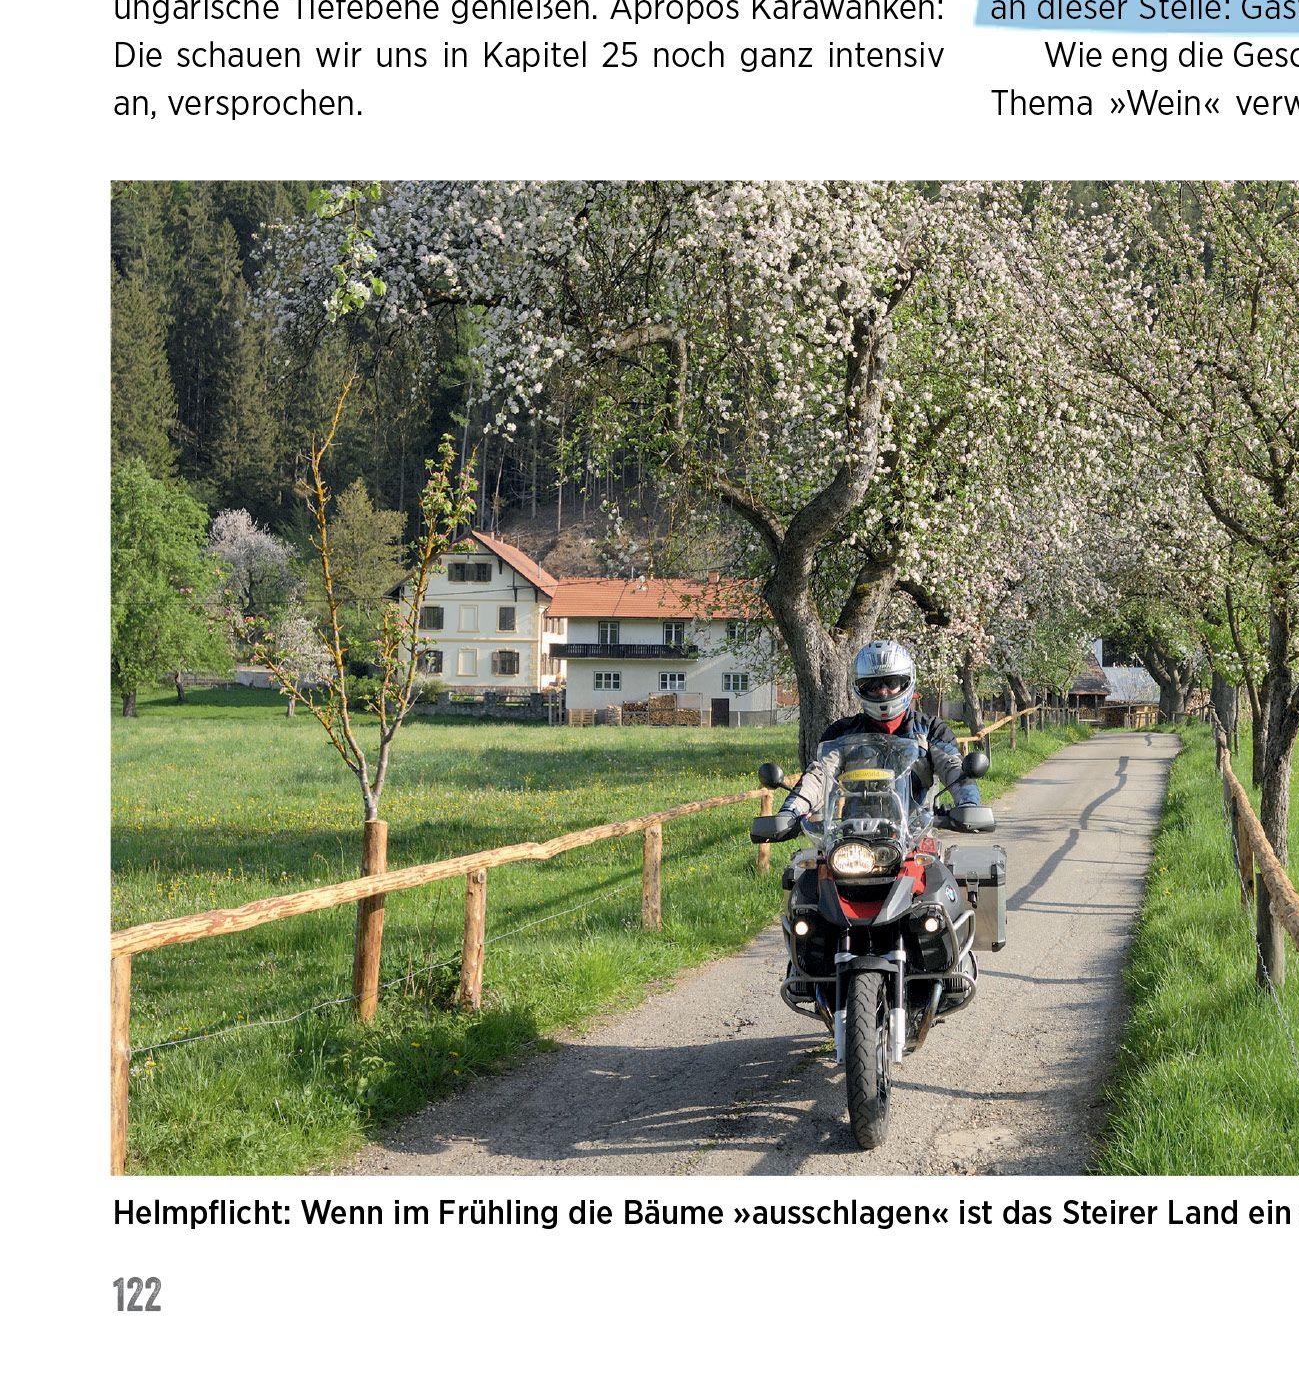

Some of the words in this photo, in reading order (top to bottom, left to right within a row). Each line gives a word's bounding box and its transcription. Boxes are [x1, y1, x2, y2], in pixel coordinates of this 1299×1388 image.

[991, 0, 1026, 20] an
[114, 1199, 290, 1230] Helmpflicht:
[300, 1199, 383, 1225] Wenn
[394, 1199, 429, 1225] im
[439, 1199, 558, 1230] Frühling
[568, 1199, 613, 1225] die
[624, 1199, 724, 1225] Bäume
[734, 1199, 949, 1230] »ausschlagen«
[959, 1199, 993, 1225] ist
[1002, 1199, 1053, 1225] das
[1062, 1199, 1158, 1225] Steirer
[1168, 1199, 1238, 1225] Land
[1248, 1199, 1291, 1225] ein
[112, 1276, 162, 1312] 122
